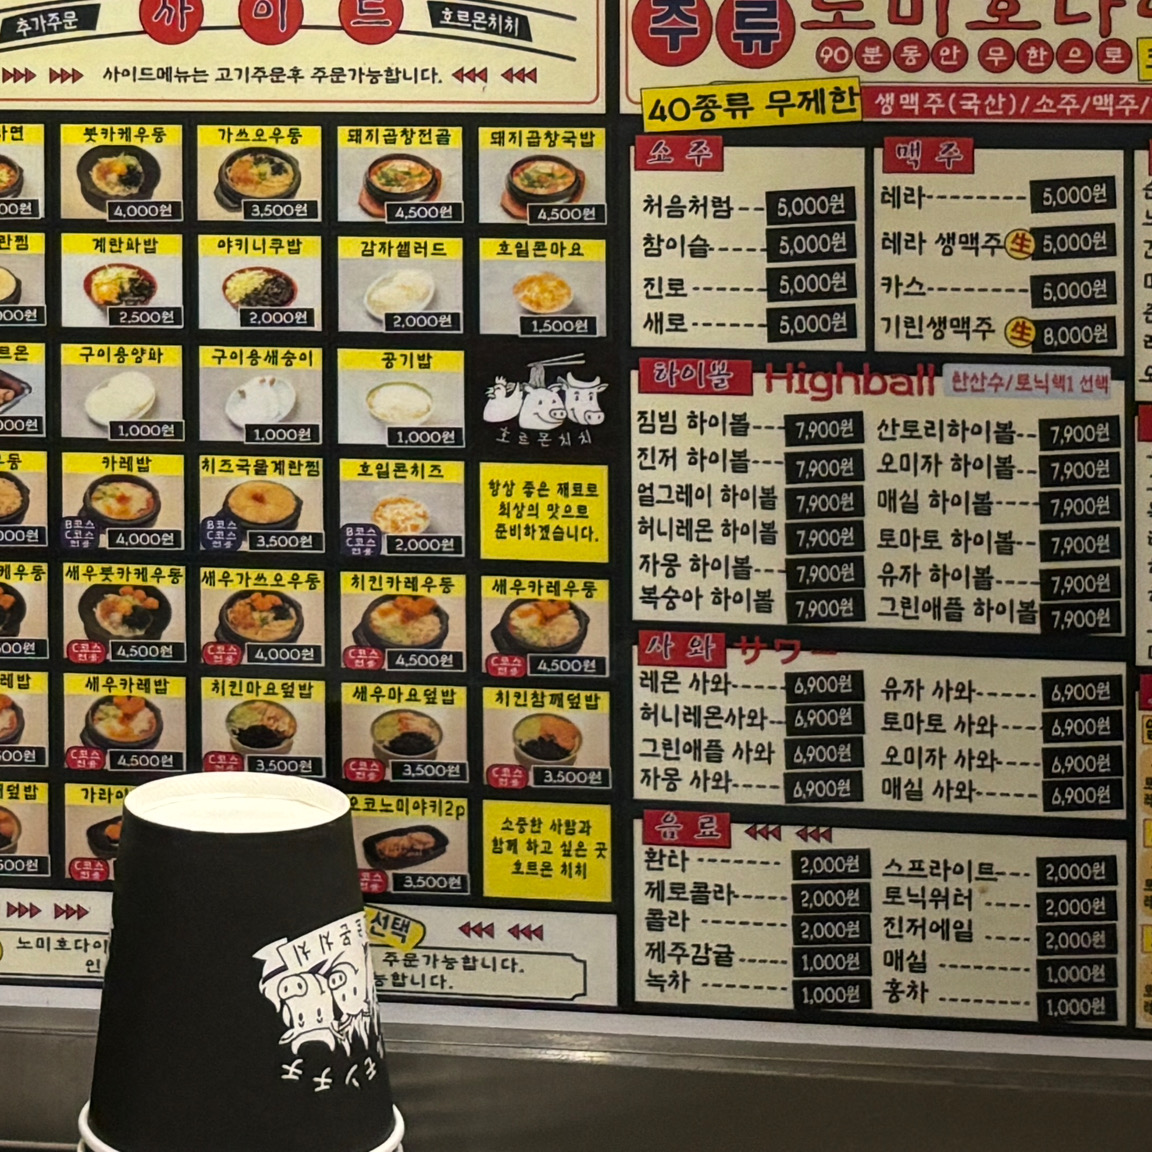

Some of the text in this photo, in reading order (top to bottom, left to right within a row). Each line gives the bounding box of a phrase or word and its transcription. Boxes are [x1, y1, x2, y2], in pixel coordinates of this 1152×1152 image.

[16, 12, 79, 37] 추가주문
[439, 8, 519, 36] 호르몬치치
[102, 66, 443, 85] 사이드메뉴는 고기주문후 주문가능합니다.
[647, 87, 858, 123] 40종류 무제한
[347, 128, 452, 145] 돼지곱창전골
[490, 130, 596, 148] 돼지곱창국밥
[642, 194, 734, 220] 처음처럼
[777, 192, 846, 217] 5,000원
[881, 186, 927, 209] 테라
[395, 205, 452, 219] 4,500원
[93, 236, 159, 254] 계란파밥
[642, 234, 711, 258] 참이슬
[881, 314, 996, 340] 기린생맥주
[1044, 323, 1109, 346] 8,000원
[79, 346, 164, 364] 구이용양파
[381, 353, 433, 369] 공기밥
[653, 361, 733, 389] 하이볼
[764, 363, 935, 402] Highball
[397, 430, 456, 444] 1,000원
[877, 419, 1017, 444] 산토리하이볼
[1050, 423, 1111, 445] 7,900원
[637, 484, 778, 511] 얼그레이 하이볼
[637, 516, 778, 546] 허니레몬 하이볼
[351, 575, 455, 592] 치킨카레우동
[640, 704, 769, 731] 허니레몬사와
[794, 707, 853, 729] 6,900원
[644, 849, 690, 872] 환타
[800, 855, 860, 876] 2,000원
[882, 859, 998, 882] 스프라이트
[644, 882, 735, 907] 제로콜라
[645, 943, 736, 968] 제주감귤
[883, 978, 929, 1004] 홍차
